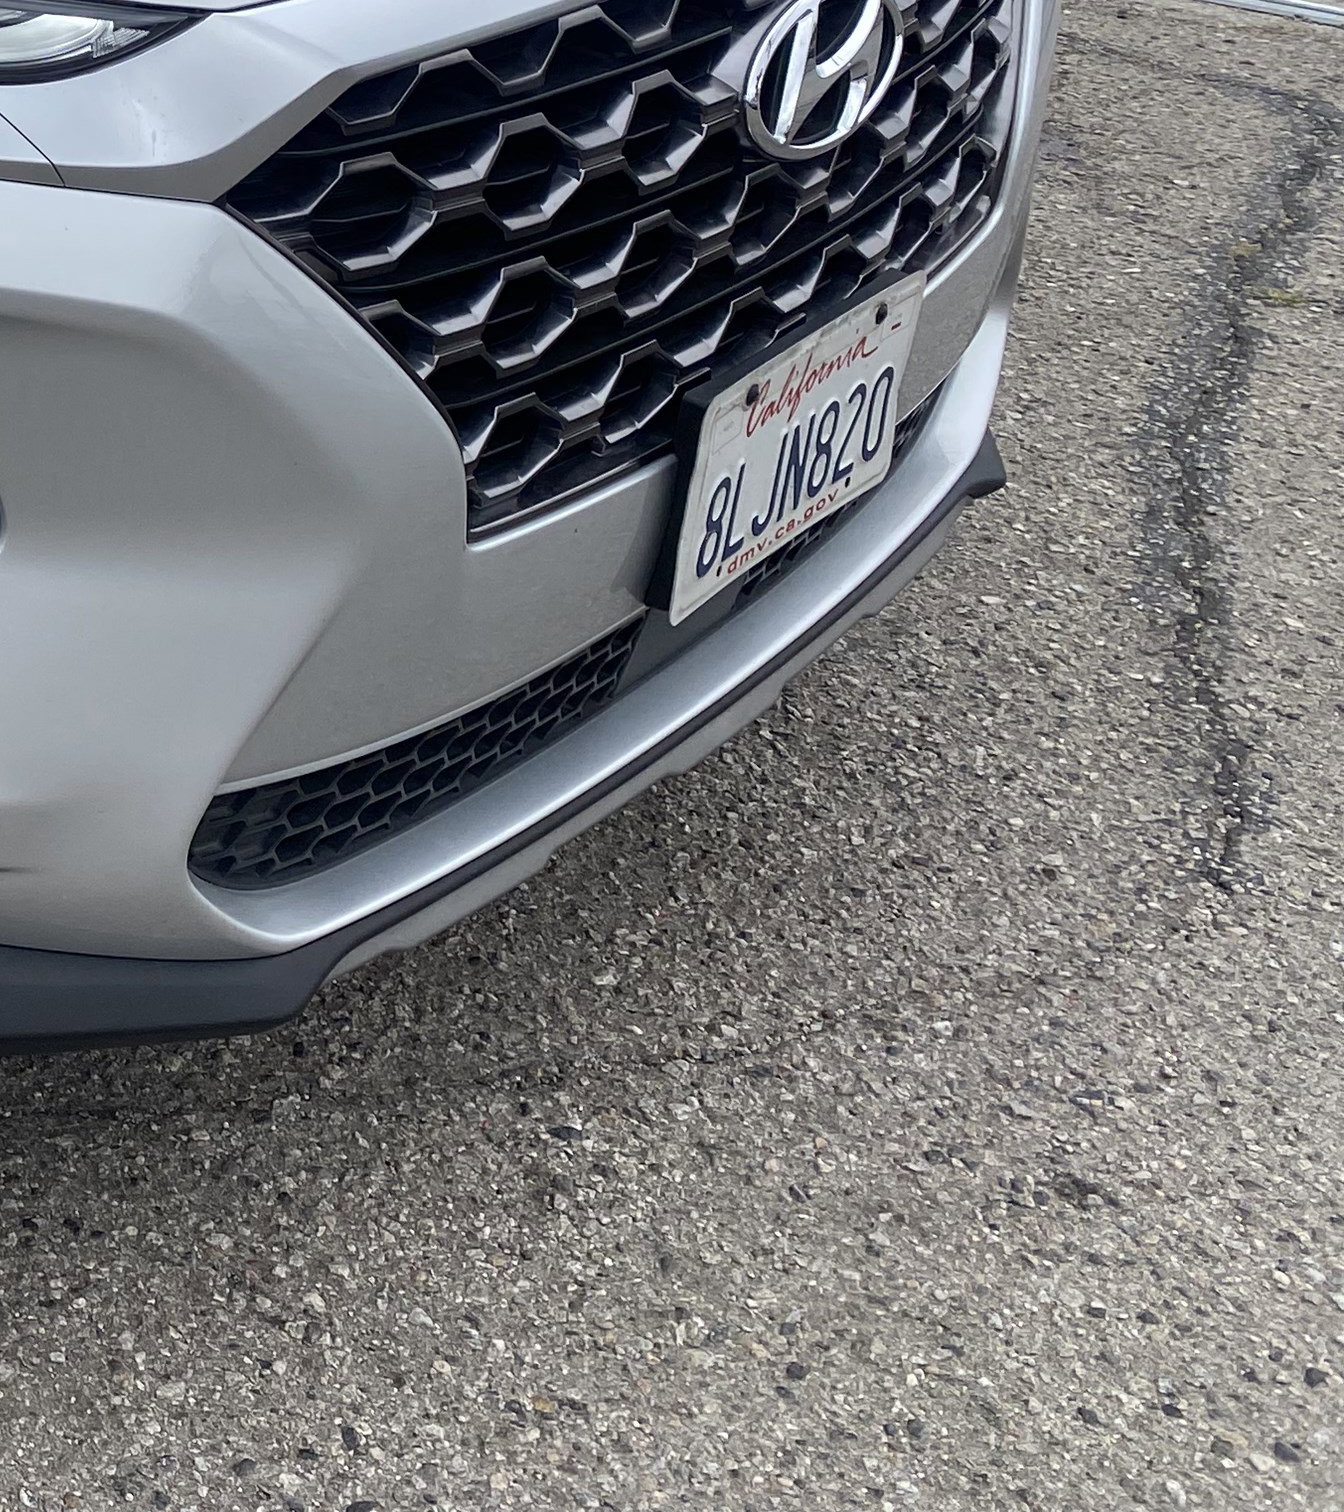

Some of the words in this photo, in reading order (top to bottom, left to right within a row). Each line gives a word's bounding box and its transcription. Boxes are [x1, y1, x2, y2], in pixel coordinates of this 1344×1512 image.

[746, 329, 878, 438] California
[696, 365, 894, 578] 8LJN820
[727, 489, 838, 575] dmv.ca.gov
